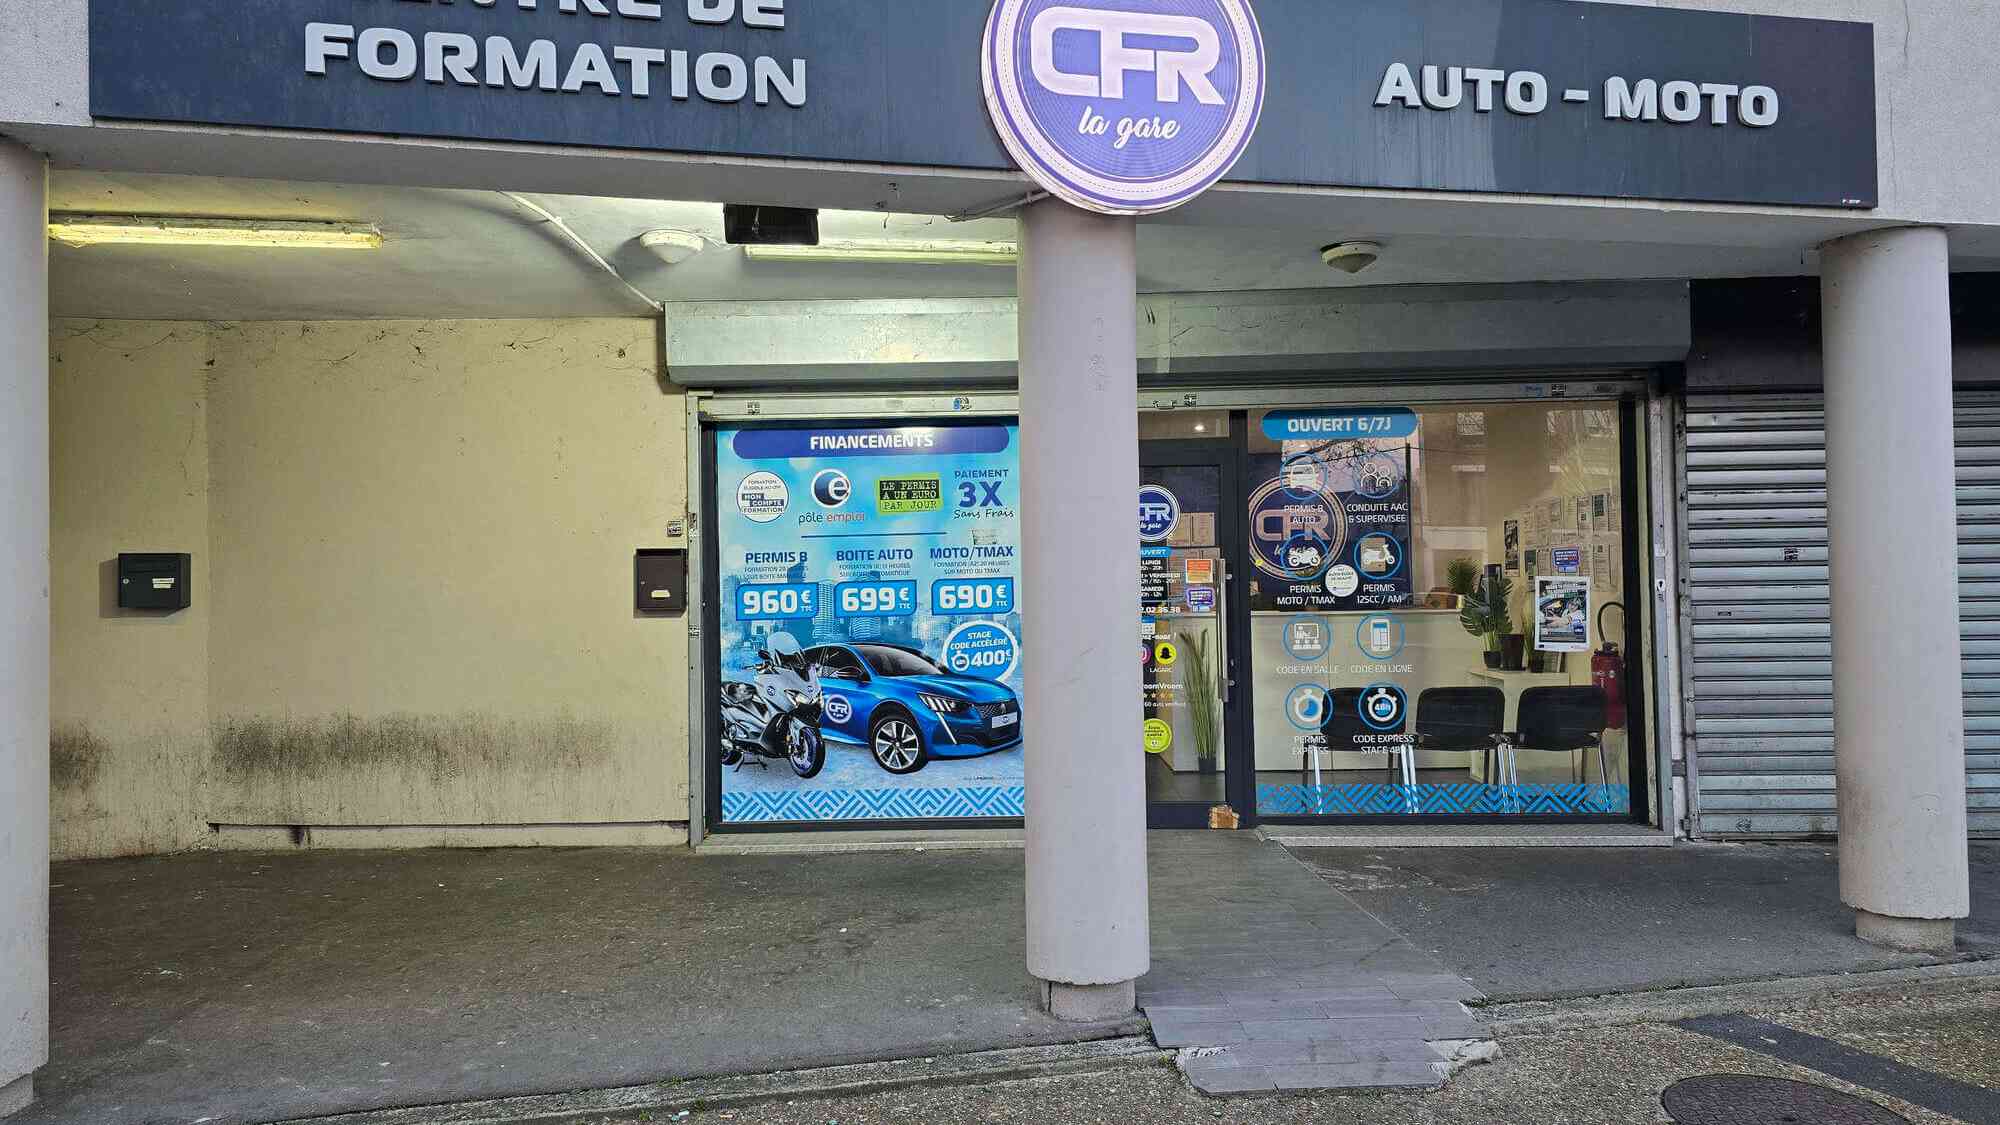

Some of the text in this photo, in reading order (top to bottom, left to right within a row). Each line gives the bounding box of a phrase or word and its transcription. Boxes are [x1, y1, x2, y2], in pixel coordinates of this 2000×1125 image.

[1031, 6, 1226, 105] CFR
[304, 22, 806, 106] FORMATION
[1374, 62, 1548, 115] AUTO
[1604, 75, 1779, 128] MOTO
[1078, 105, 1181, 150] la gare
[1287, 418, 1353, 432] OUVERT
[810, 433, 934, 450] FINANCEMENTS
[954, 469, 1009, 479] PAIEMENT
[882, 481, 937, 491] LE PERMIS
[958, 480, 1003, 508] 3X
[1346, 502, 1408, 512] CONDUITE AAC
[745, 552, 807, 563] PERMIS B
[836, 549, 913, 561] BOITE AUTO
[930, 546, 1013, 560] MOTO/TMAX
[1289, 584, 1322, 594] PERMIS
[1362, 583, 1396, 593] PERMIS
[1276, 596, 1303, 605] MOTO
[1311, 595, 1336, 605] TMAX
[1387, 594, 1402, 604] AM
[967, 631, 992, 640] STAGE
[1352, 734, 1415, 744] CODE EXPRESS
